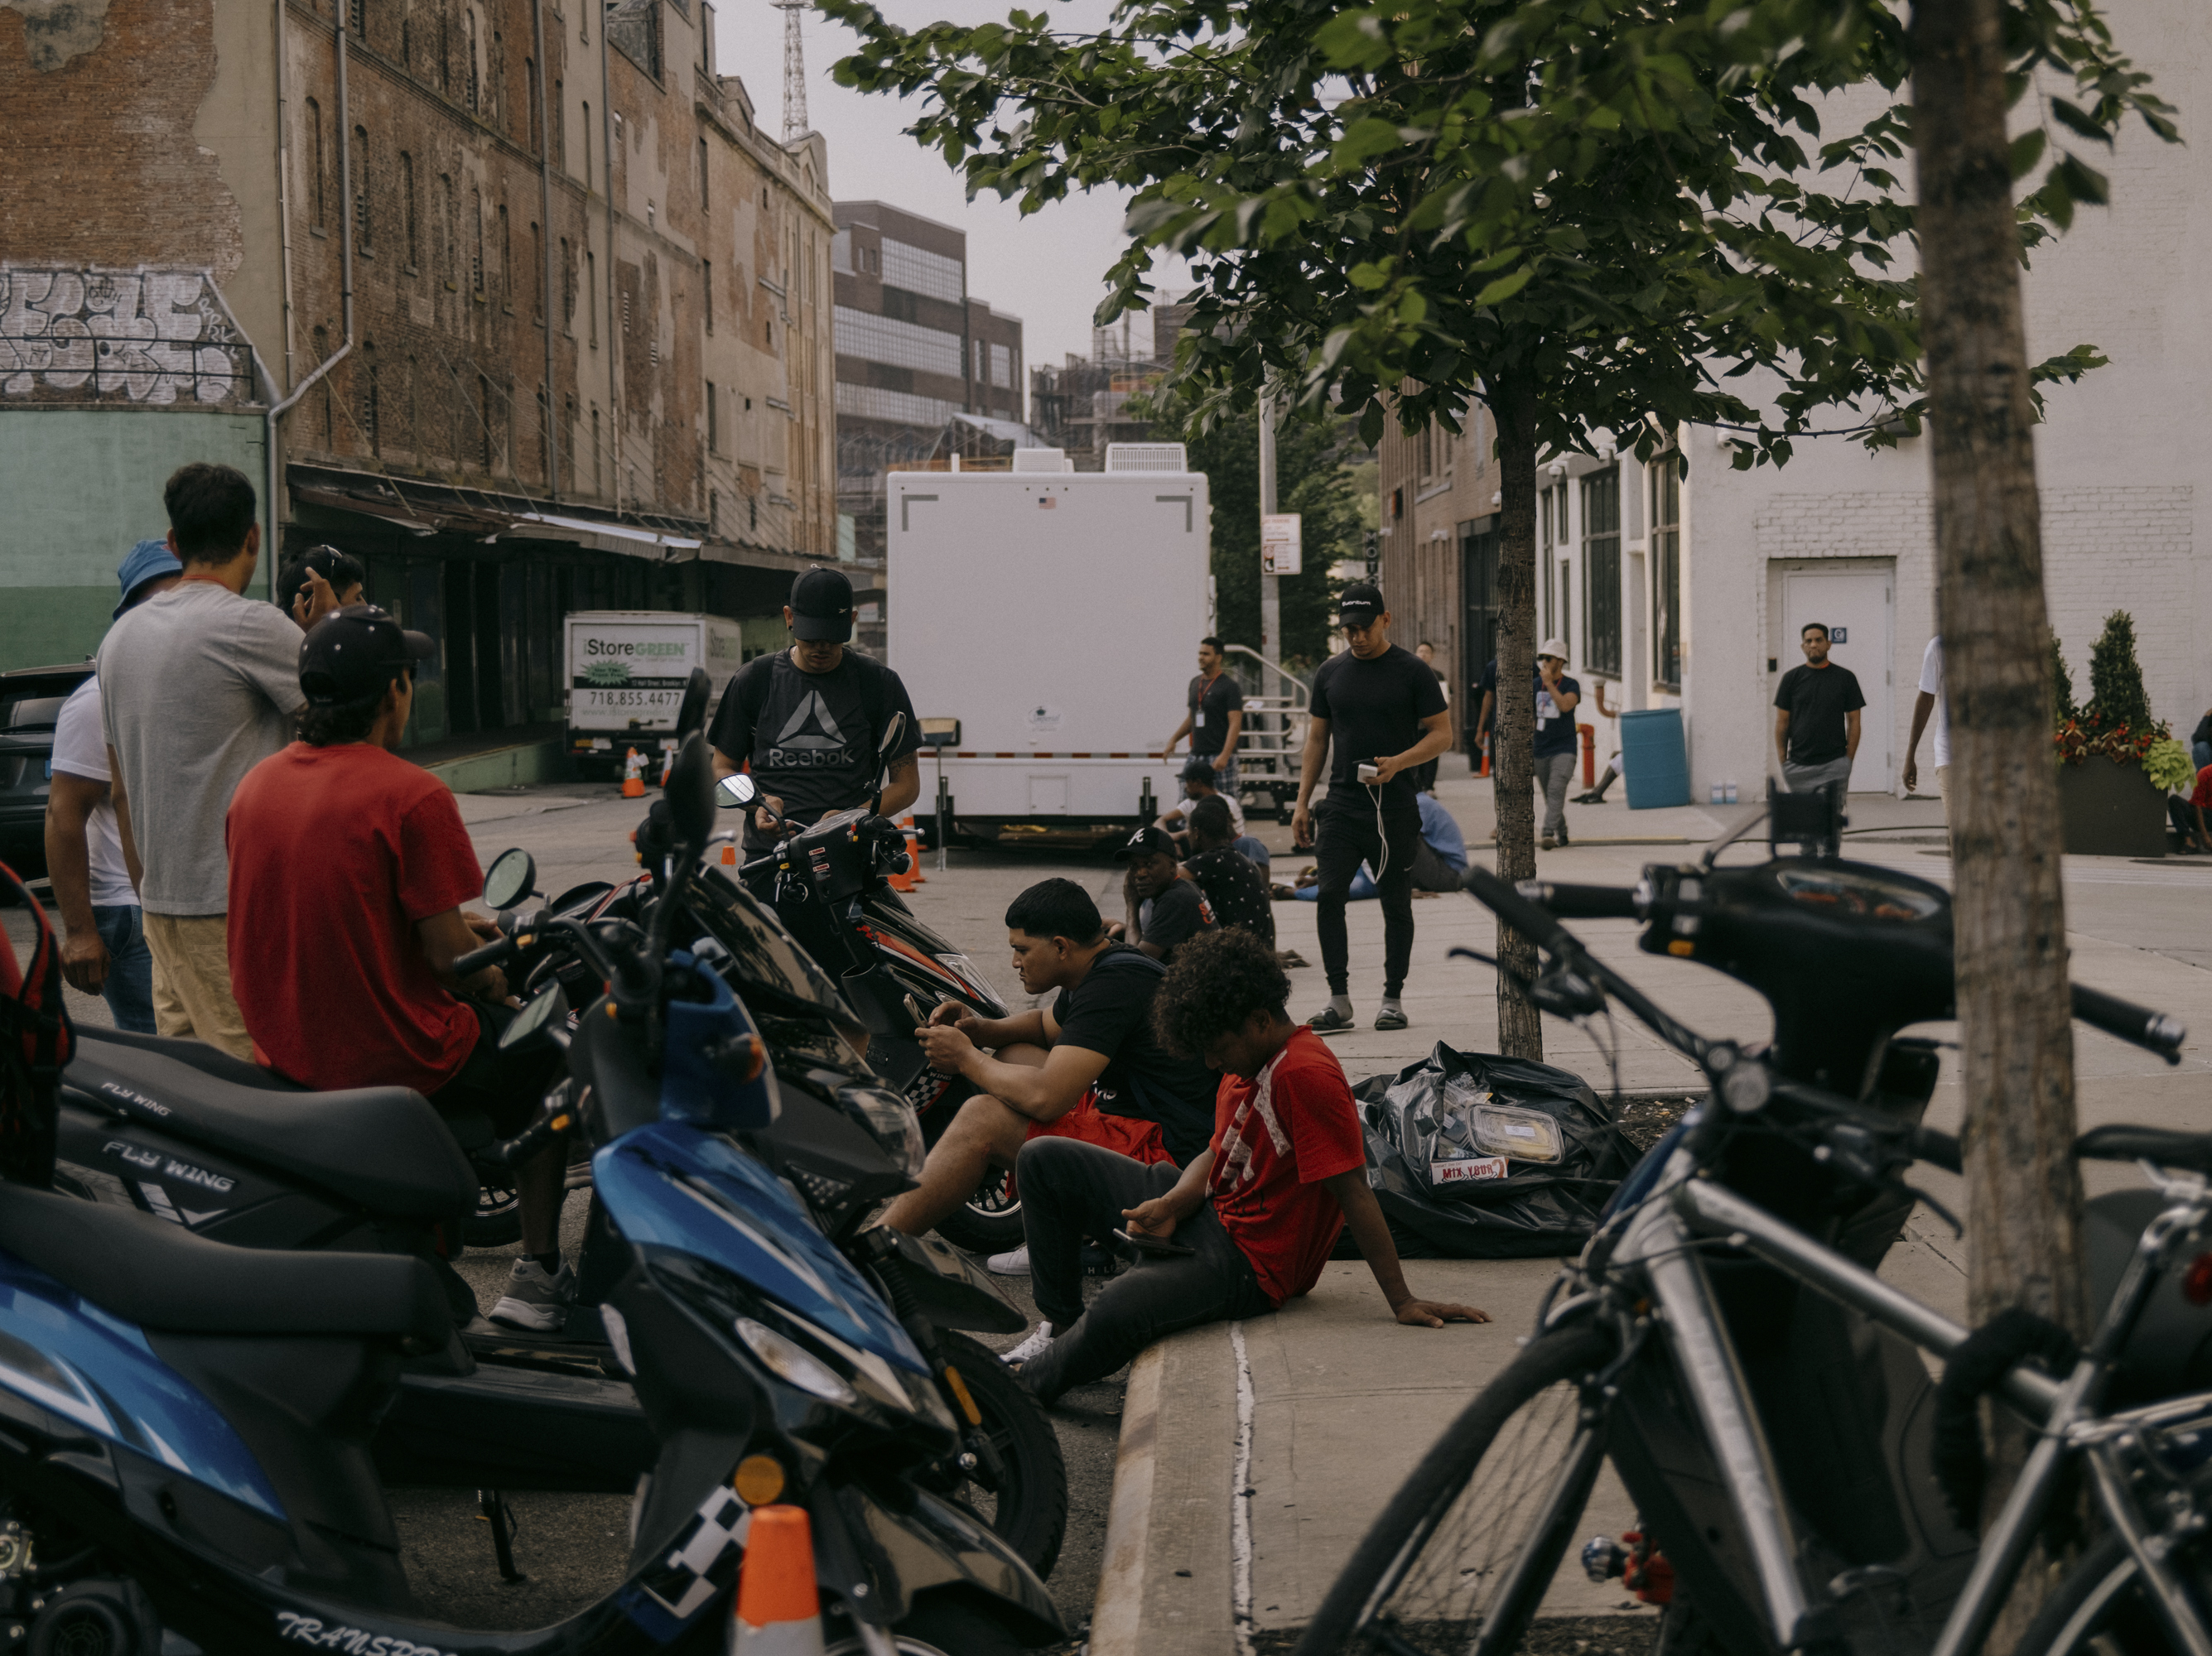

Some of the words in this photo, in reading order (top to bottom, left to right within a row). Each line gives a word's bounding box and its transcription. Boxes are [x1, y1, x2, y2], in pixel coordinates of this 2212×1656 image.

[590, 691, 680, 705] 718.855.4477
[769, 748, 855, 767] Reebok
[101, 1082, 133, 1098] FLY
[134, 1094, 171, 1116] WING
[103, 1142, 161, 1167] FLY
[166, 1160, 235, 1192] WING
[1443, 1167, 1463, 1179] MIX
[1467, 1164, 1493, 1176] YOUR
